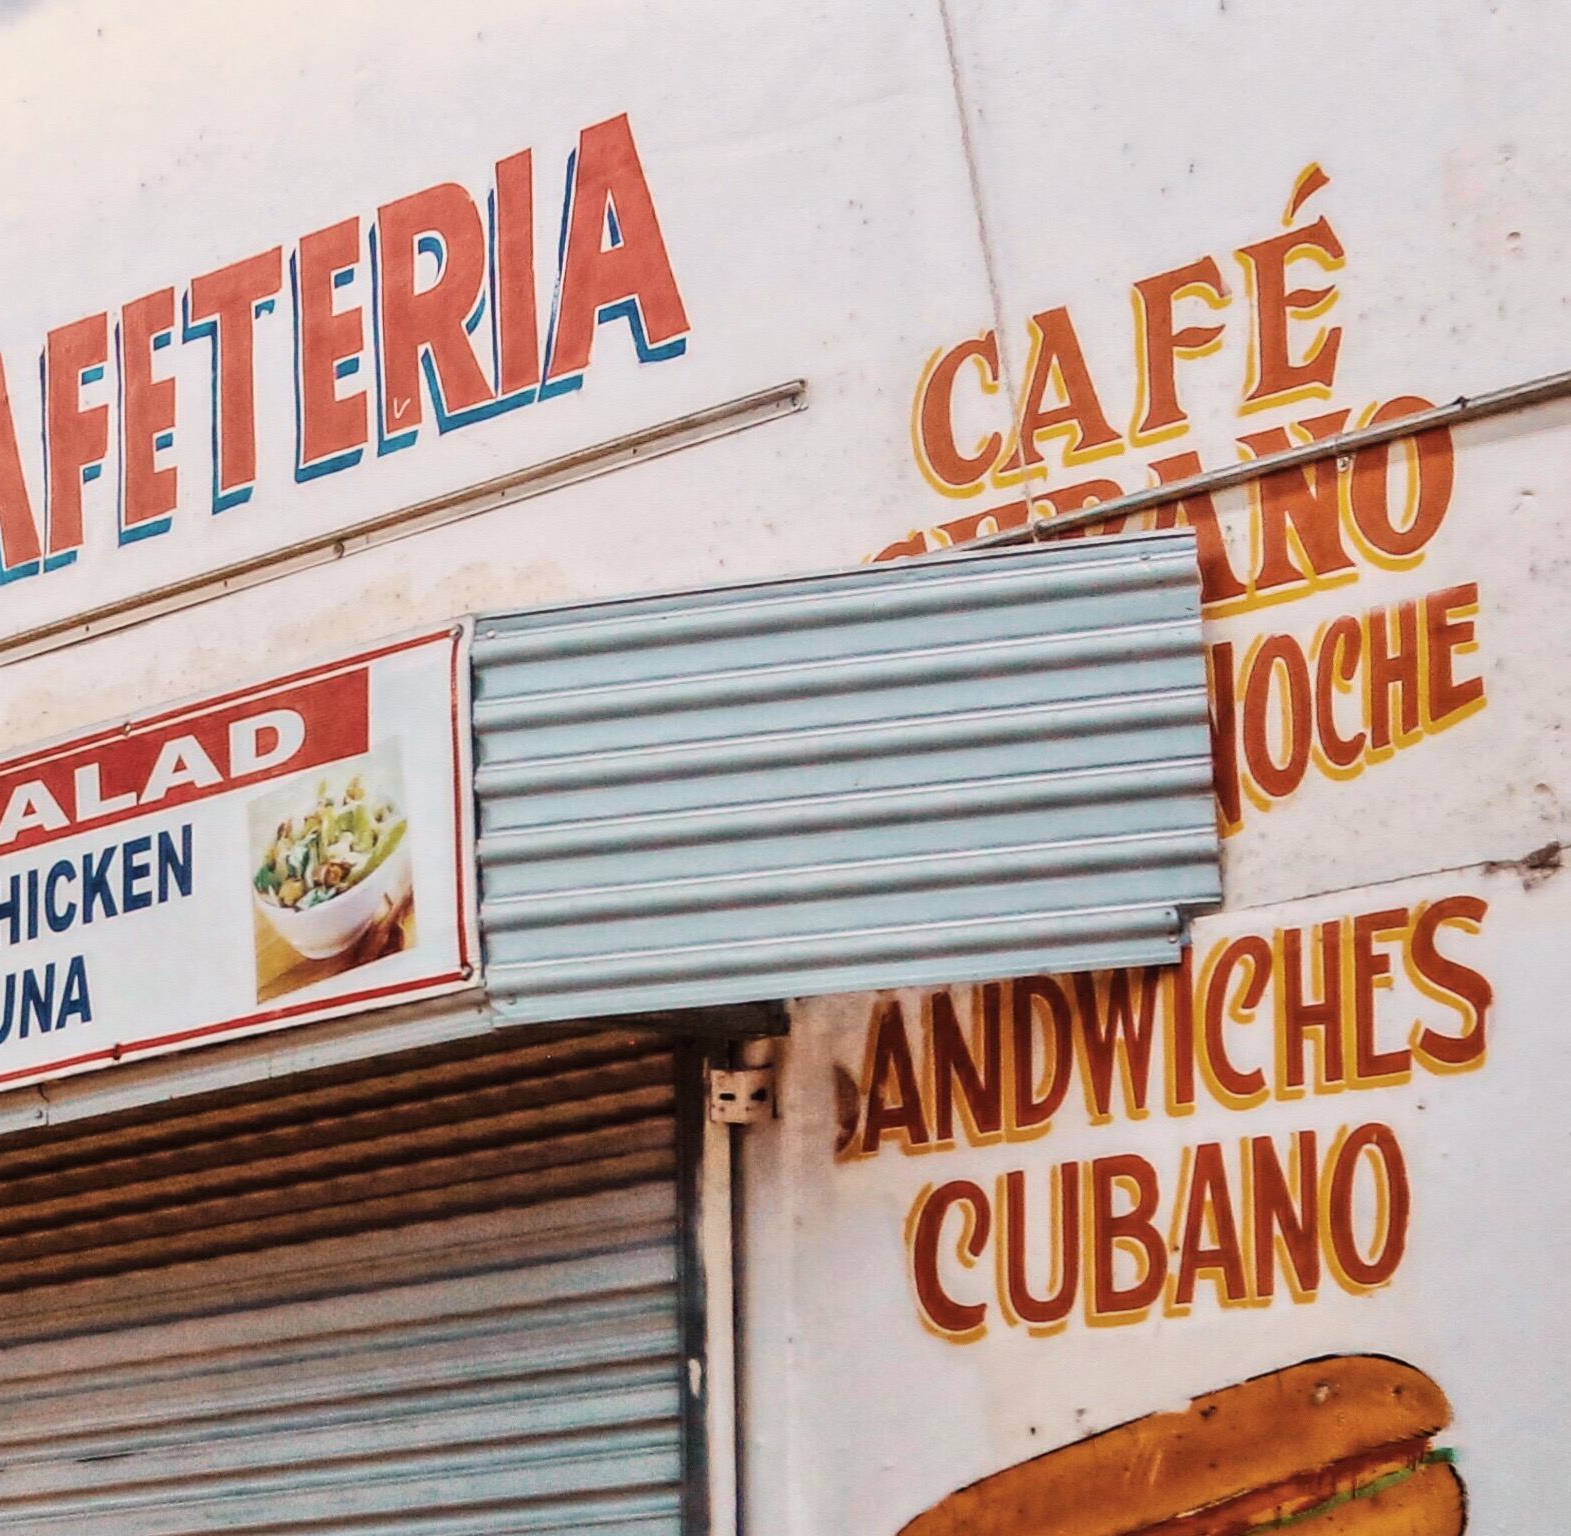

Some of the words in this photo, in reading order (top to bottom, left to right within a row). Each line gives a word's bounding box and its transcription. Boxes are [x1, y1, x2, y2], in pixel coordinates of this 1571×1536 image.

[912, 161, 1347, 500] CAFÉ
[835, 895, 1494, 1163] ANDWICHES
[905, 1121, 1411, 1344] CUBANO
